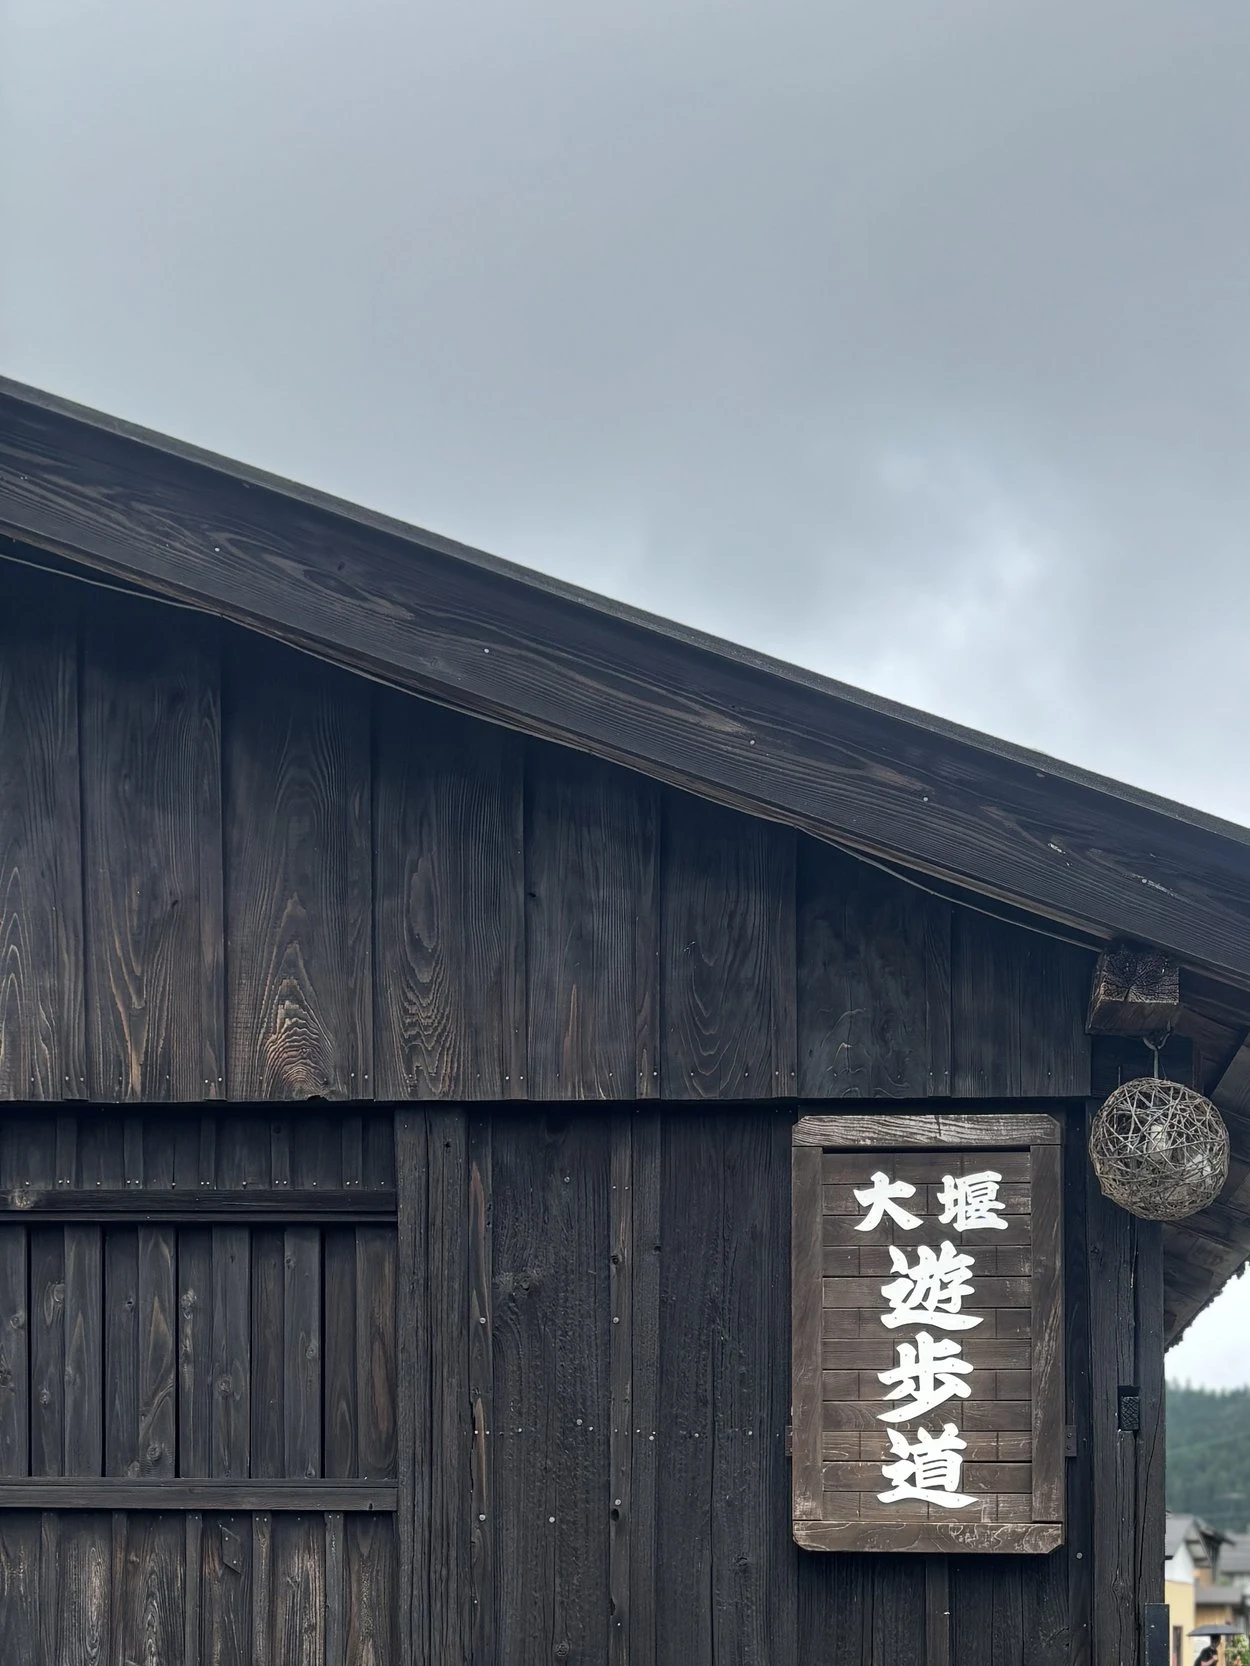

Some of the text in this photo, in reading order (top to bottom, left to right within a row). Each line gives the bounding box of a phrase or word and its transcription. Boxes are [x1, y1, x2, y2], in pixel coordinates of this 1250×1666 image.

[854, 1171, 1008, 1232] 大堰
[876, 1240, 984, 1509] 遊歩道
